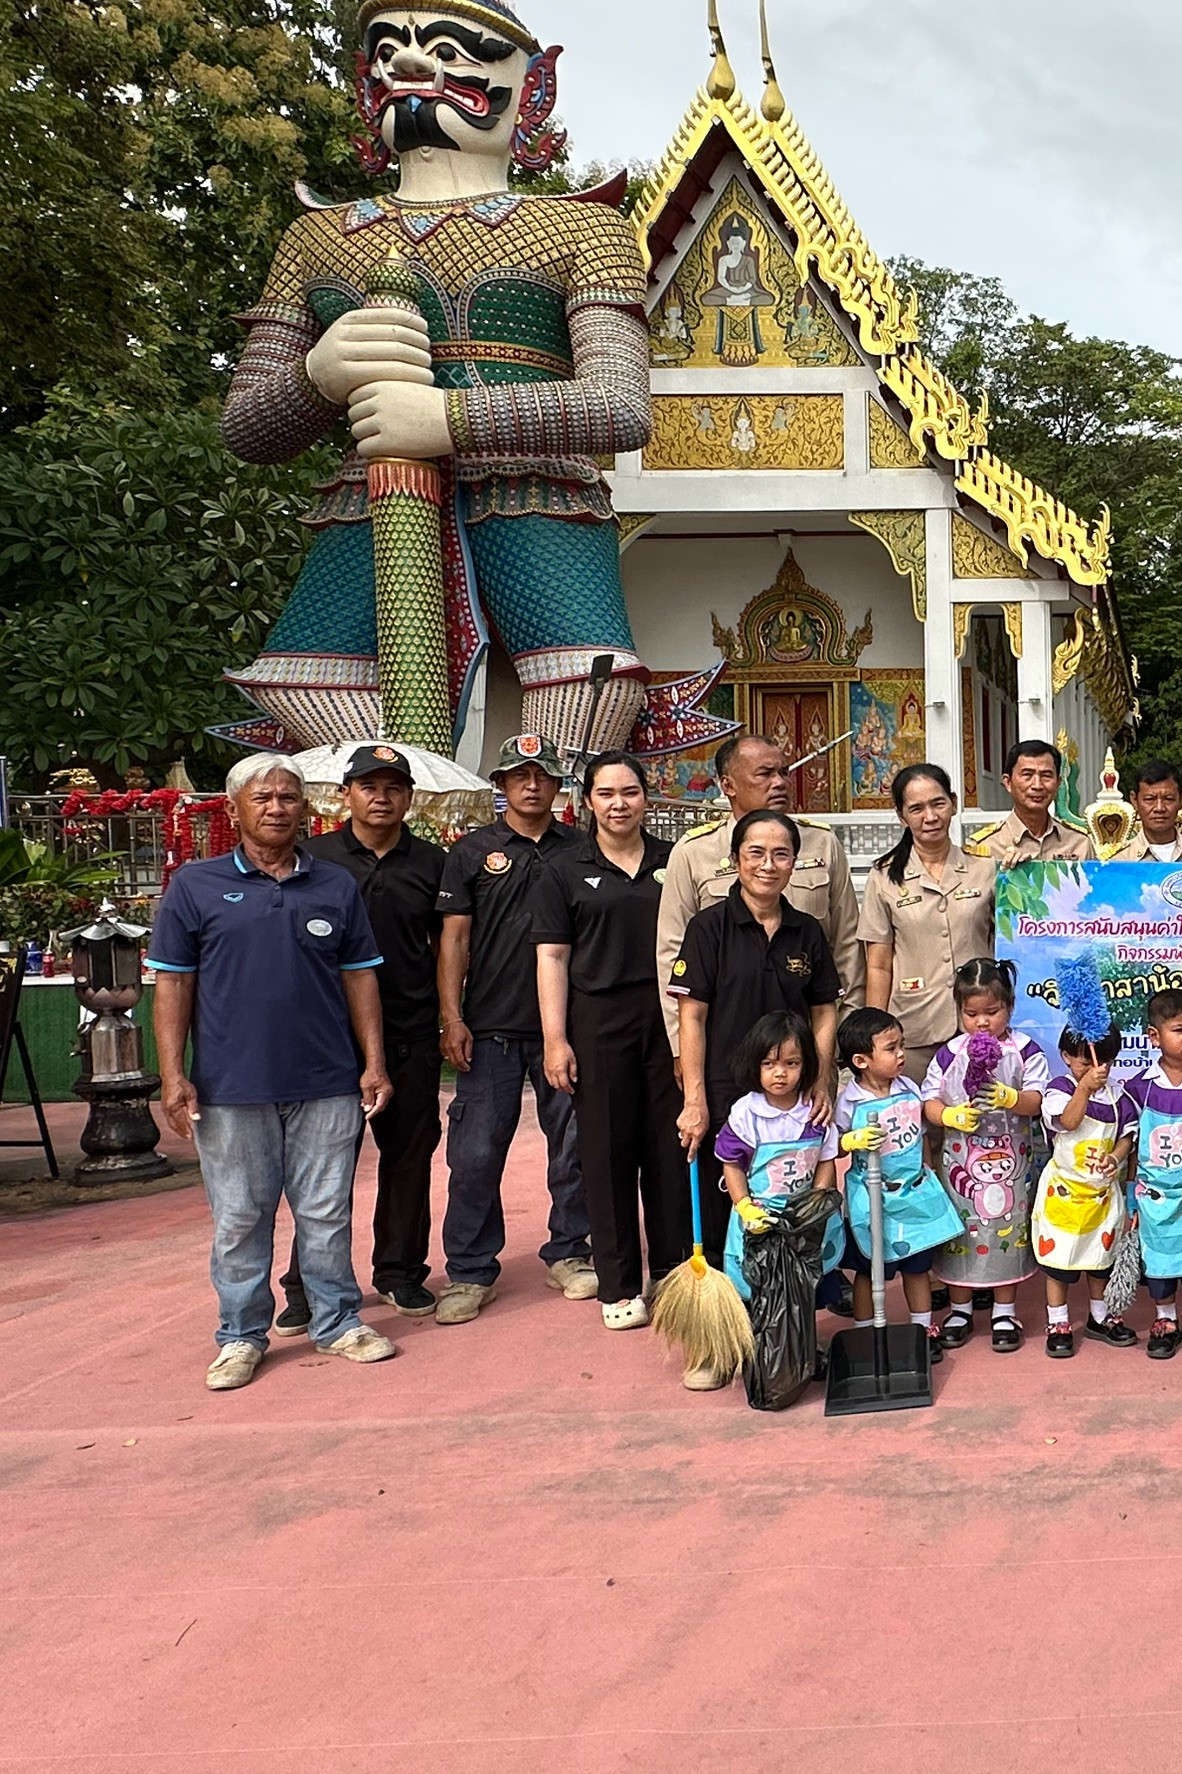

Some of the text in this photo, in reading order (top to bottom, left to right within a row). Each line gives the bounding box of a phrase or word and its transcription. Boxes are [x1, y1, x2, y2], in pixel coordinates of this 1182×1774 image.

[887, 1116, 901, 1133] I
[891, 1123, 920, 1149] YOU
[1160, 1135, 1172, 1150] I
[1086, 1147, 1098, 1160] I
[783, 1160, 796, 1176] I
[1085, 1163, 1104, 1175] YO
[783, 1169, 815, 1194] YOU
